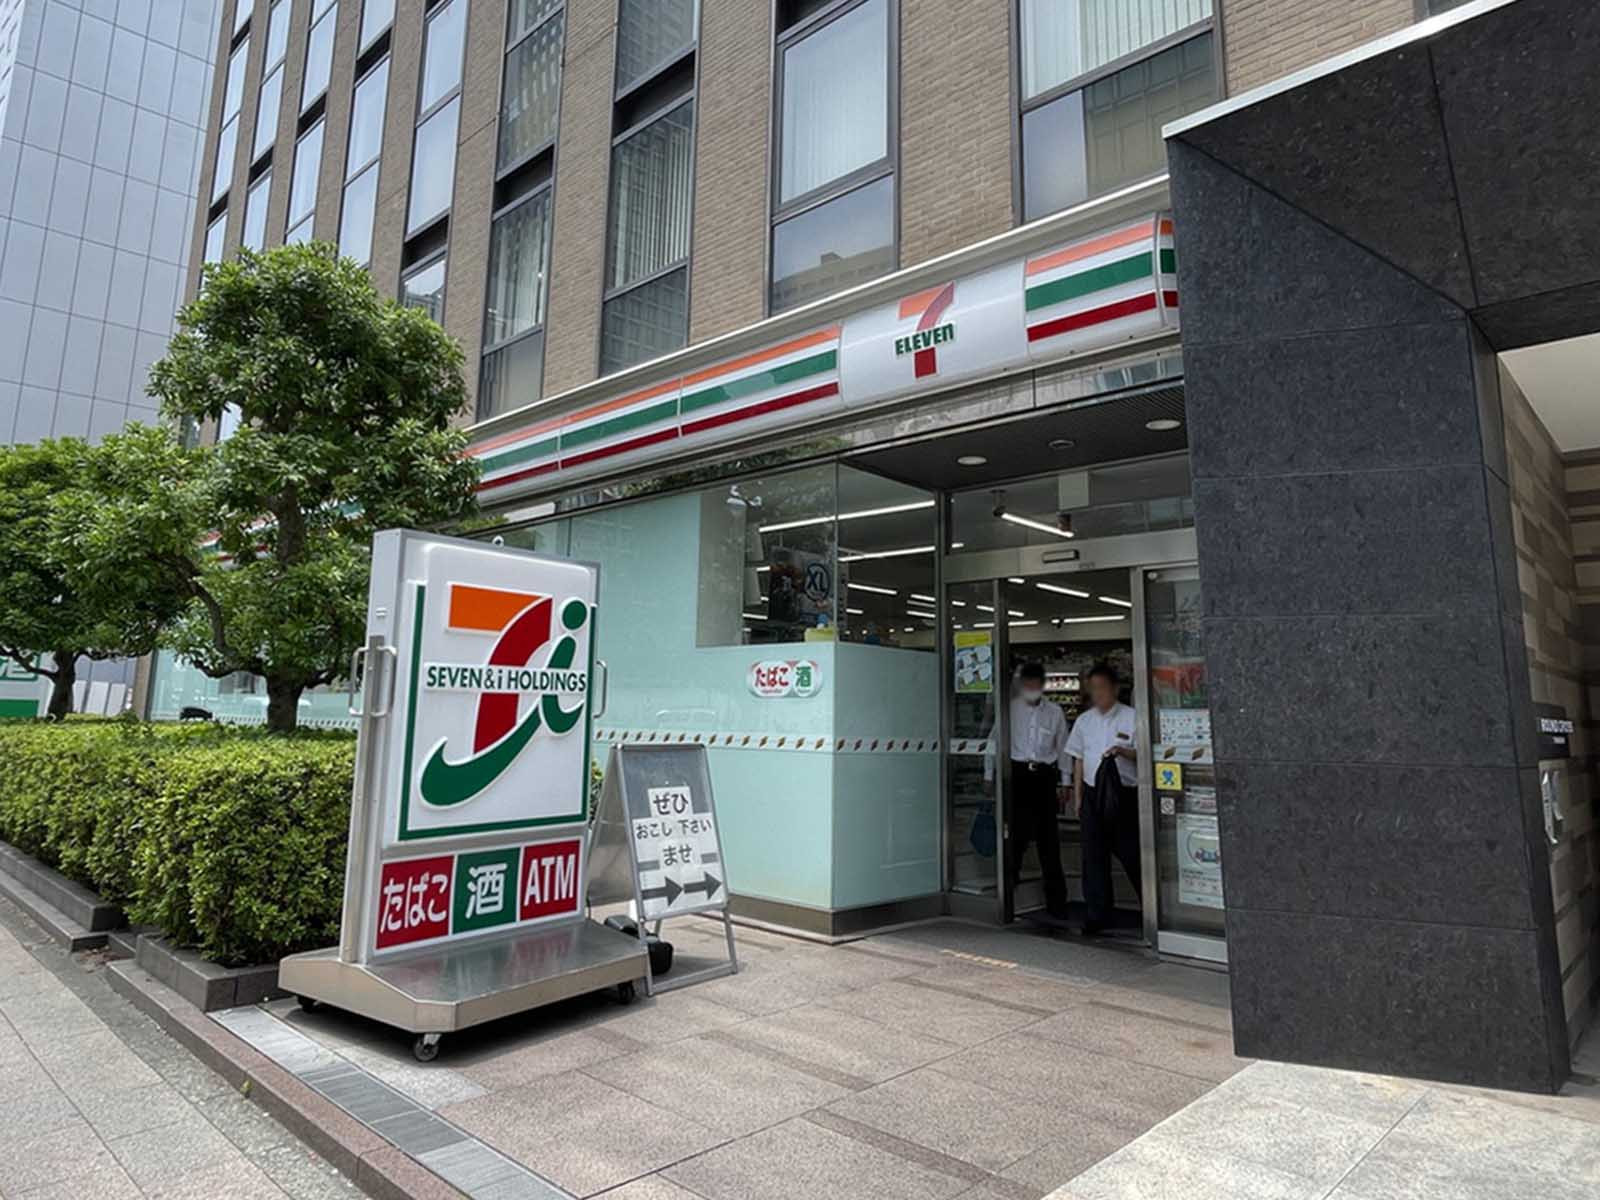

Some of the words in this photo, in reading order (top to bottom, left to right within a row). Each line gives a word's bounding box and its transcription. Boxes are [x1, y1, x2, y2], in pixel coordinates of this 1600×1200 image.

[507, 670, 586, 693] HOLDINGS
[754, 666, 789, 688] たばこ
[795, 666, 812, 688] 酒
[653, 792, 689, 815] ぜひ
[636, 822, 673, 840] おこし
[678, 818, 712, 836] 下さい
[663, 844, 692, 866] ませ
[380, 872, 449, 934] たばこ
[465, 863, 508, 919] 酒
[524, 854, 576, 907] ATM
